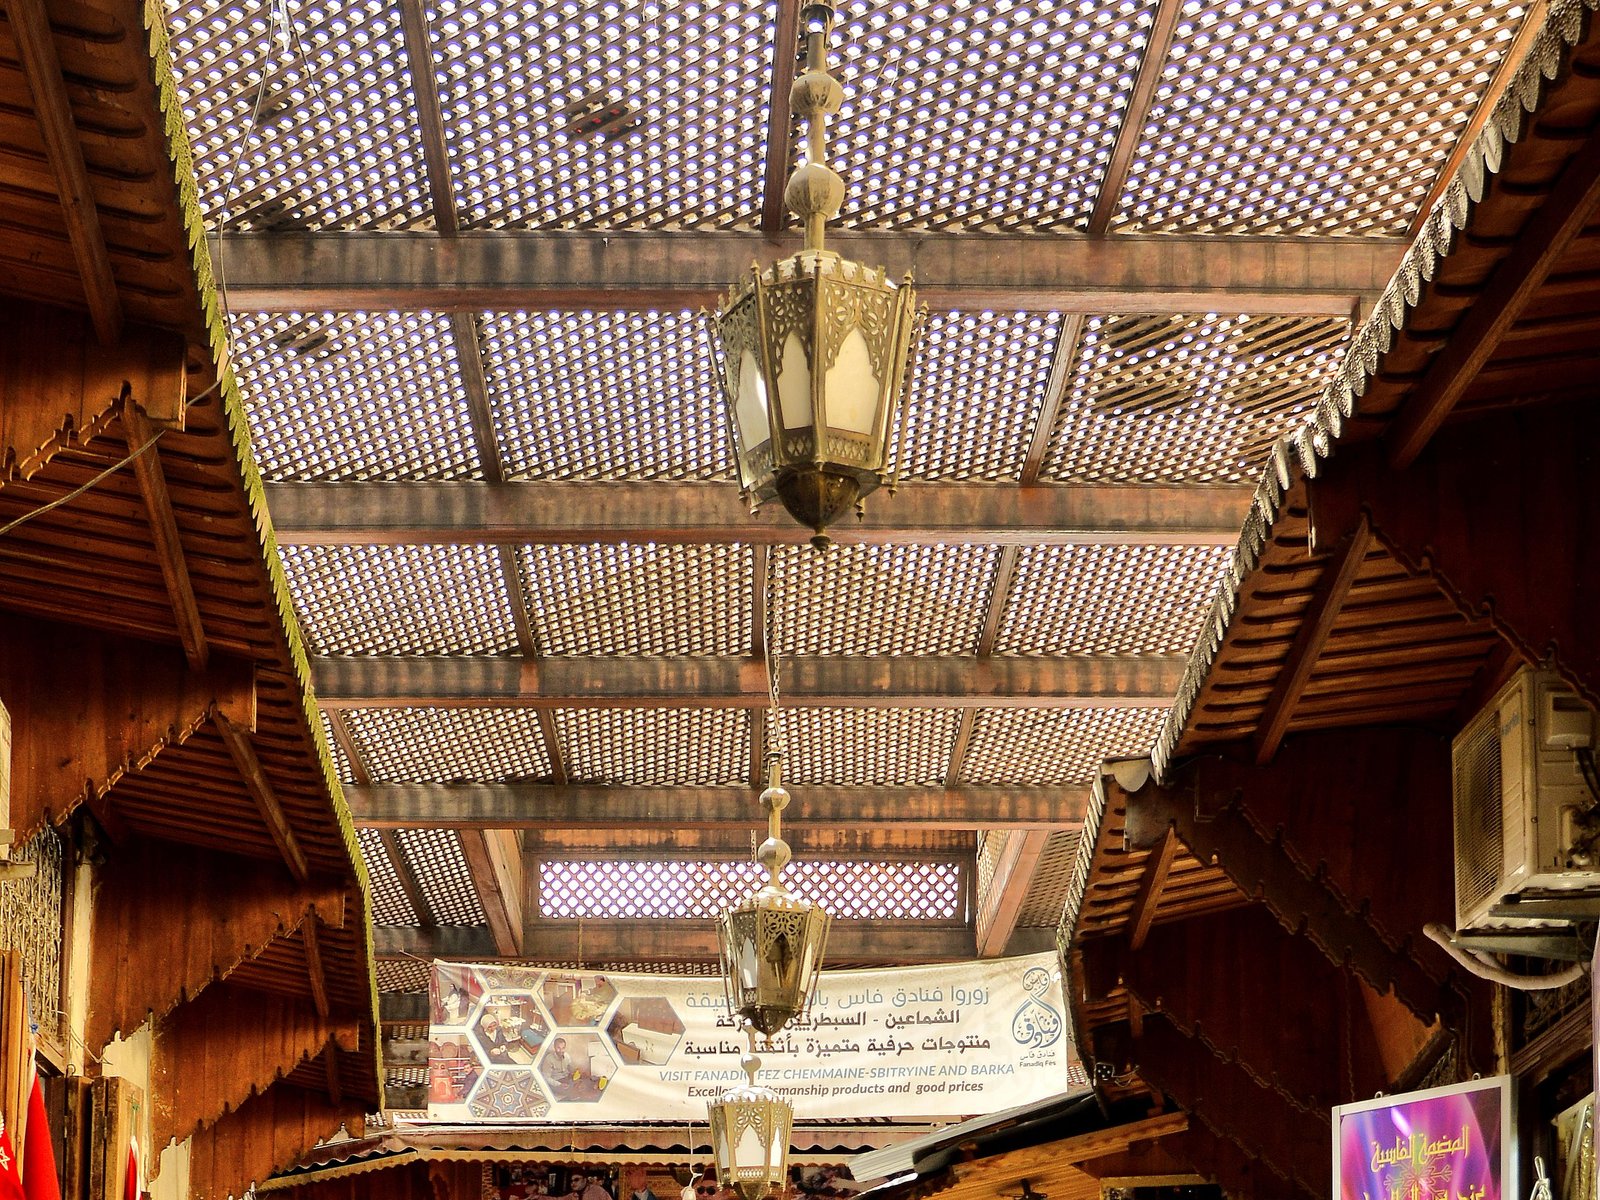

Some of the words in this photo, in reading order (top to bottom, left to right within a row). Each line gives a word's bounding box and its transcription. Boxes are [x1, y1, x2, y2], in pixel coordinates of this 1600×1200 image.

[838, 989, 883, 1009] فاس
[892, 987, 943, 1008] فنادق
[951, 986, 989, 1006] زوروا
[885, 1008, 960, 1029] الشماعين
[684, 1041, 741, 1060] مناسبة
[806, 1038, 860, 1058] متميزة
[867, 1034, 914, 1057] حرفية
[922, 1034, 991, 1054] منتوجات
[659, 1070, 691, 1081] VISIT
[757, 1069, 780, 1080] FEZ
[783, 1065, 937, 1081] CHEMMAINE-SBITRYINE
[938, 1064, 968, 1077] AND
[971, 1063, 1015, 1076] BARKA
[1019, 1060, 1043, 1068] Fanadiq
[832, 1083, 885, 1098] products
[888, 1081, 910, 1094] and
[916, 1081, 946, 1095] good
[948, 1080, 984, 1094] prices
